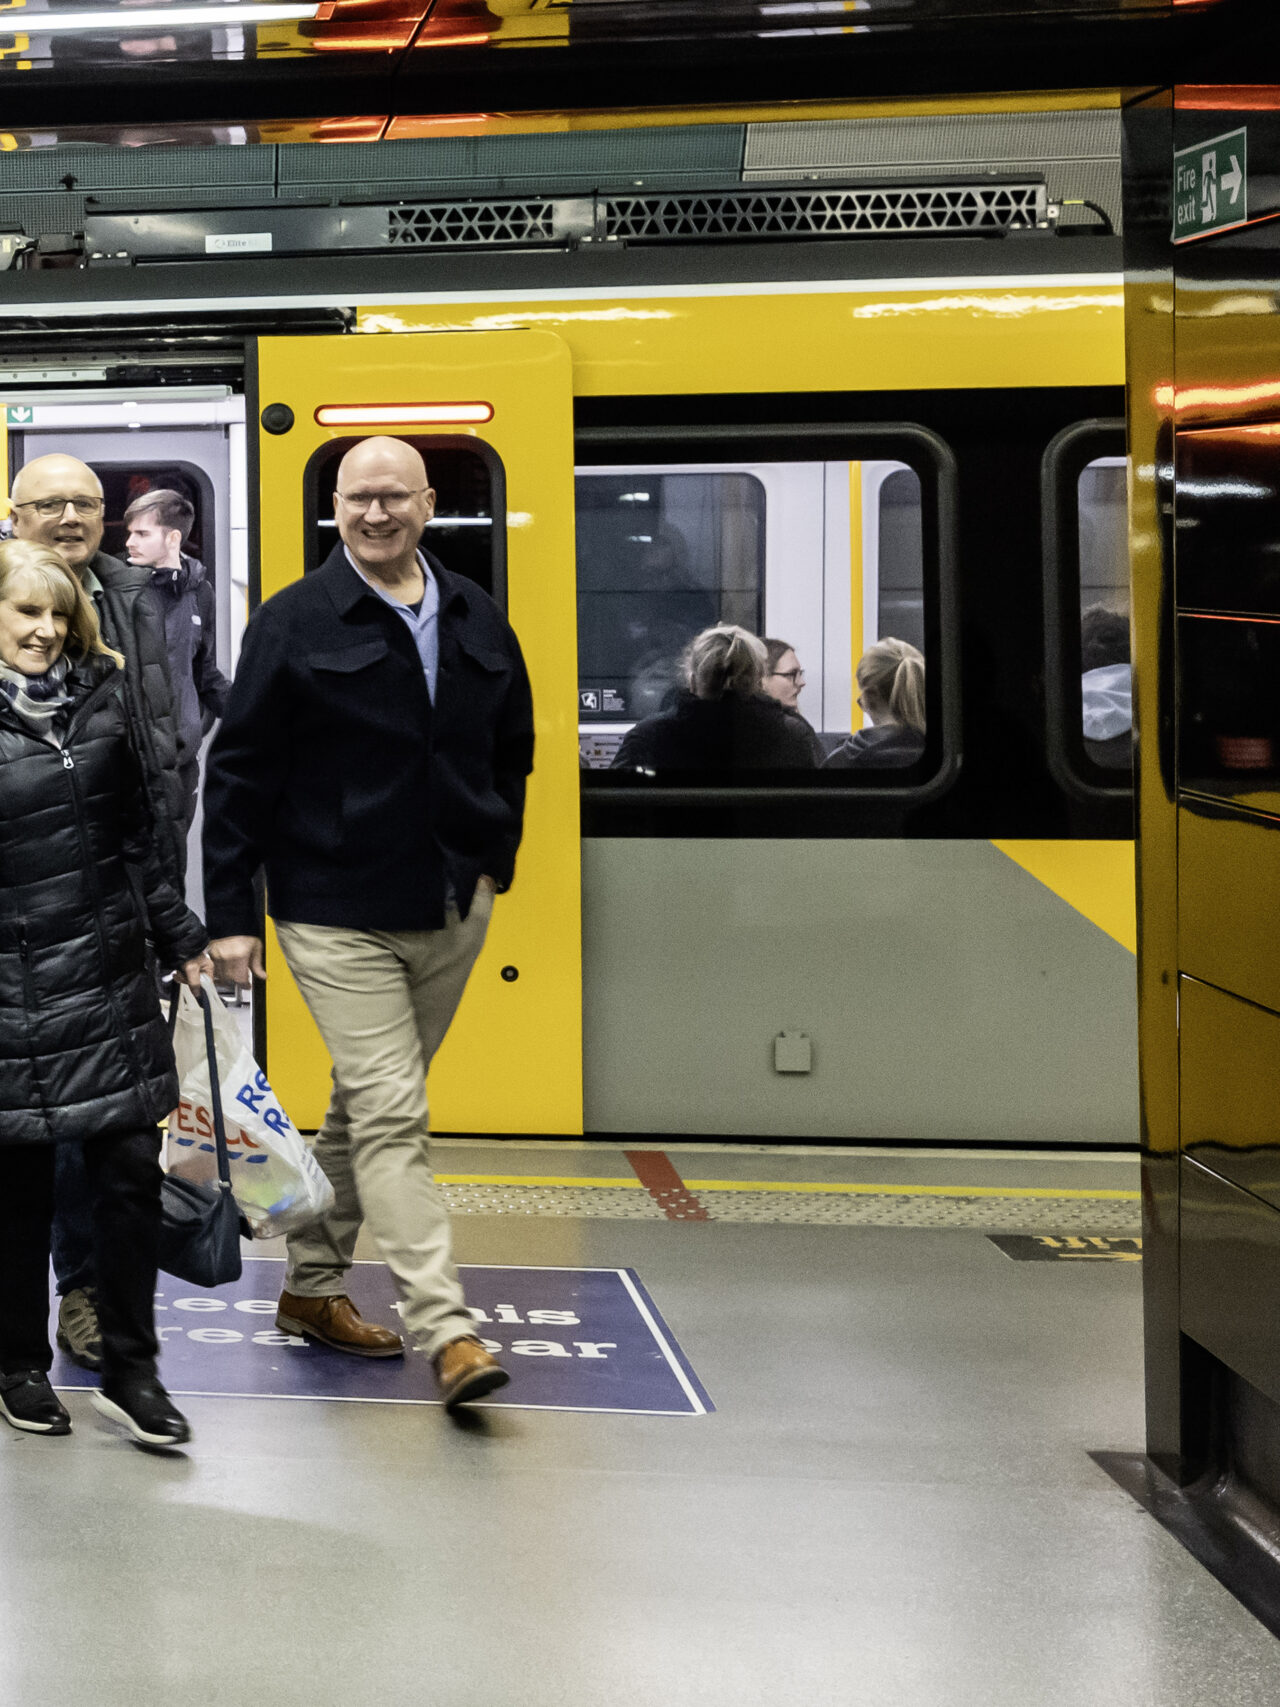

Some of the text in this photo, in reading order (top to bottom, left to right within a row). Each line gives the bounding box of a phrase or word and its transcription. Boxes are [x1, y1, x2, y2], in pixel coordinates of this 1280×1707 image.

[1177, 165, 1196, 193] Fire
[1177, 195, 1196, 225] exit
[262, 1107, 290, 1138] R
[155, 1293, 278, 1314] ee
